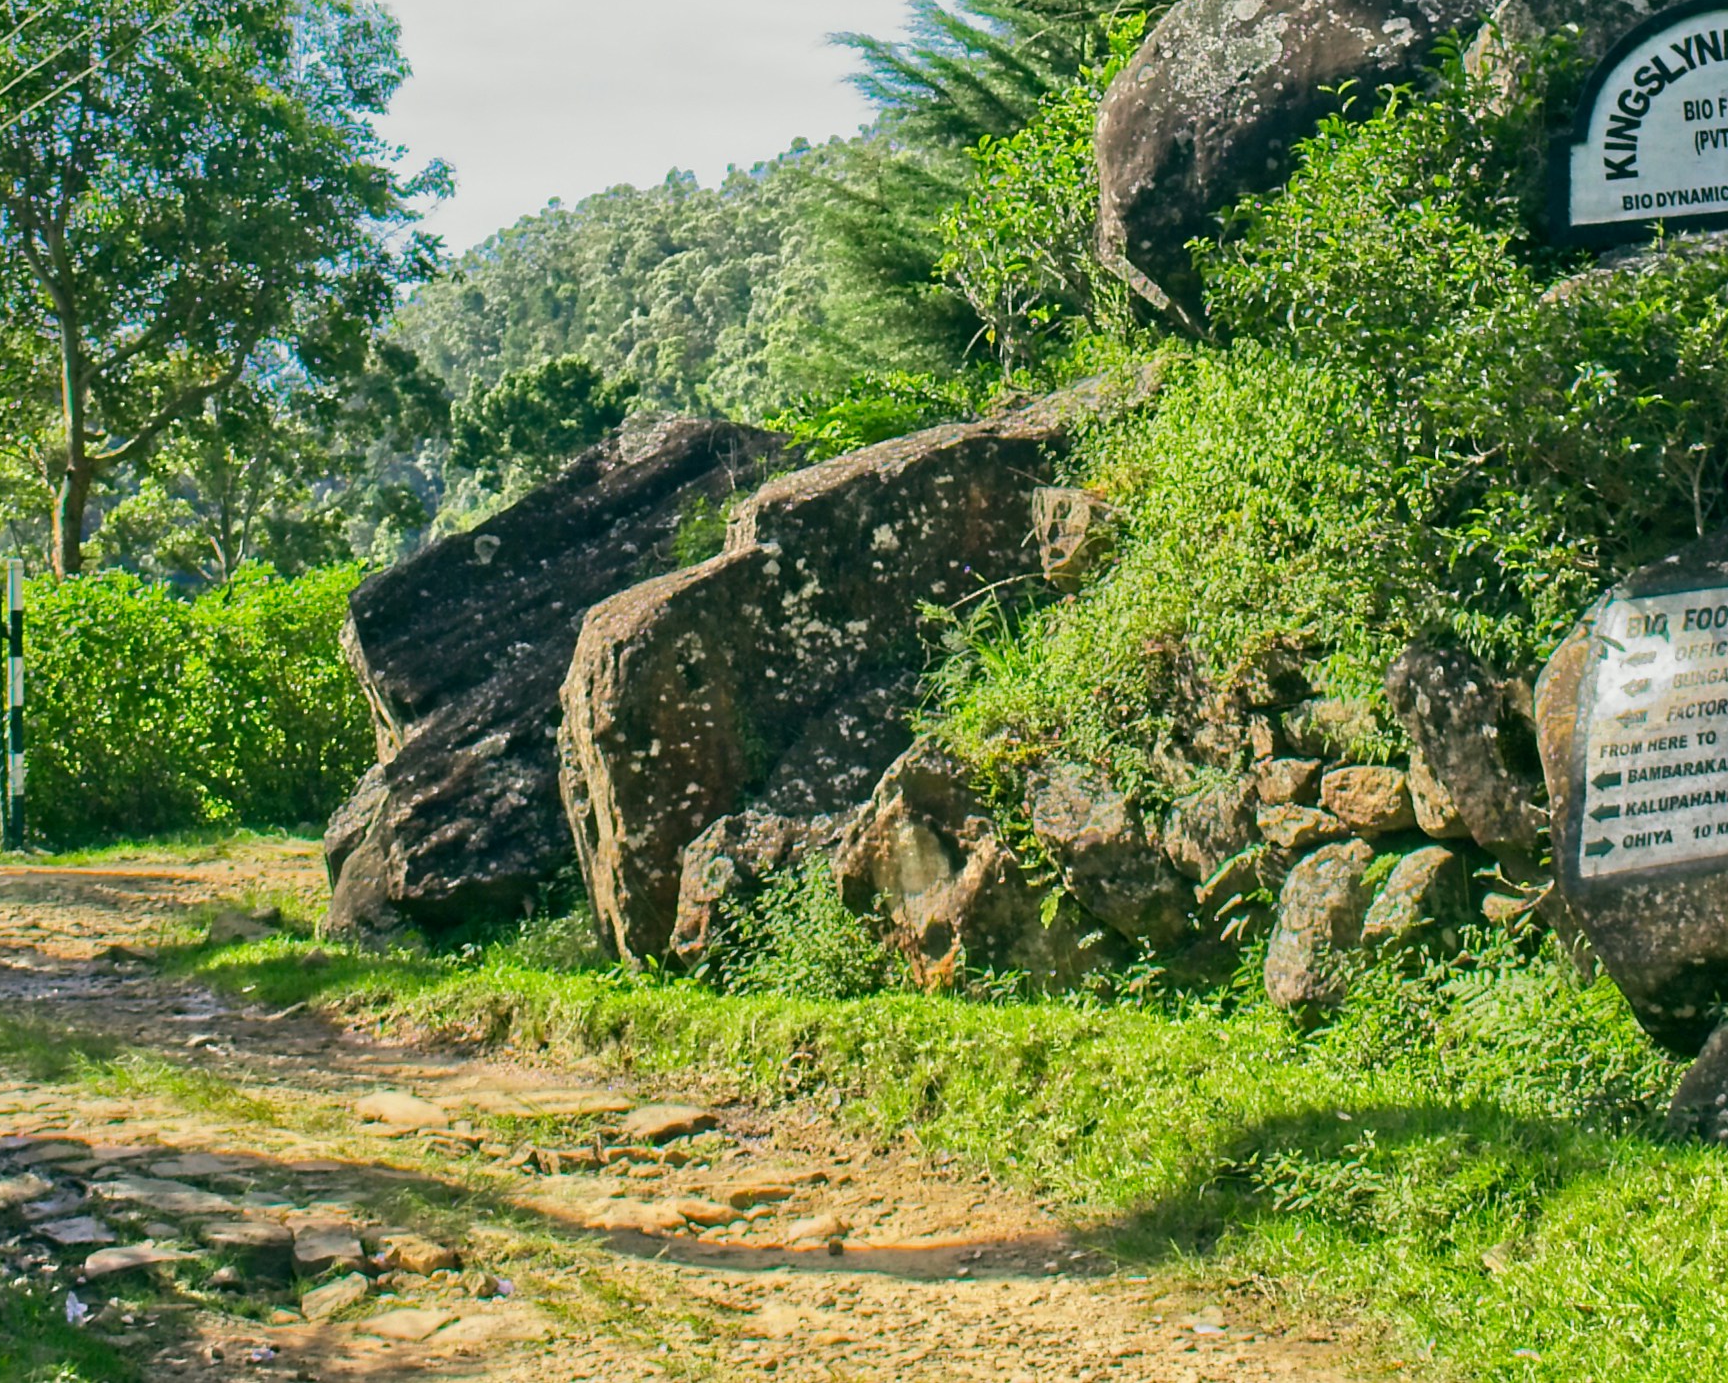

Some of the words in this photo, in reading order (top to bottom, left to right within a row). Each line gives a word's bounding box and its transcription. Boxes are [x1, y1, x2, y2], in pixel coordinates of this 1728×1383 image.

[1683, 99, 1713, 121] BIO
[1622, 193, 1653, 211] BIO
[1625, 612, 1668, 639] BIO
[1600, 742, 1642, 759] FROM
[1647, 735, 1688, 753] HERE
[1696, 730, 1717, 746] TO
[1622, 829, 1673, 849] OHIYA
[1692, 824, 1711, 839] 10
